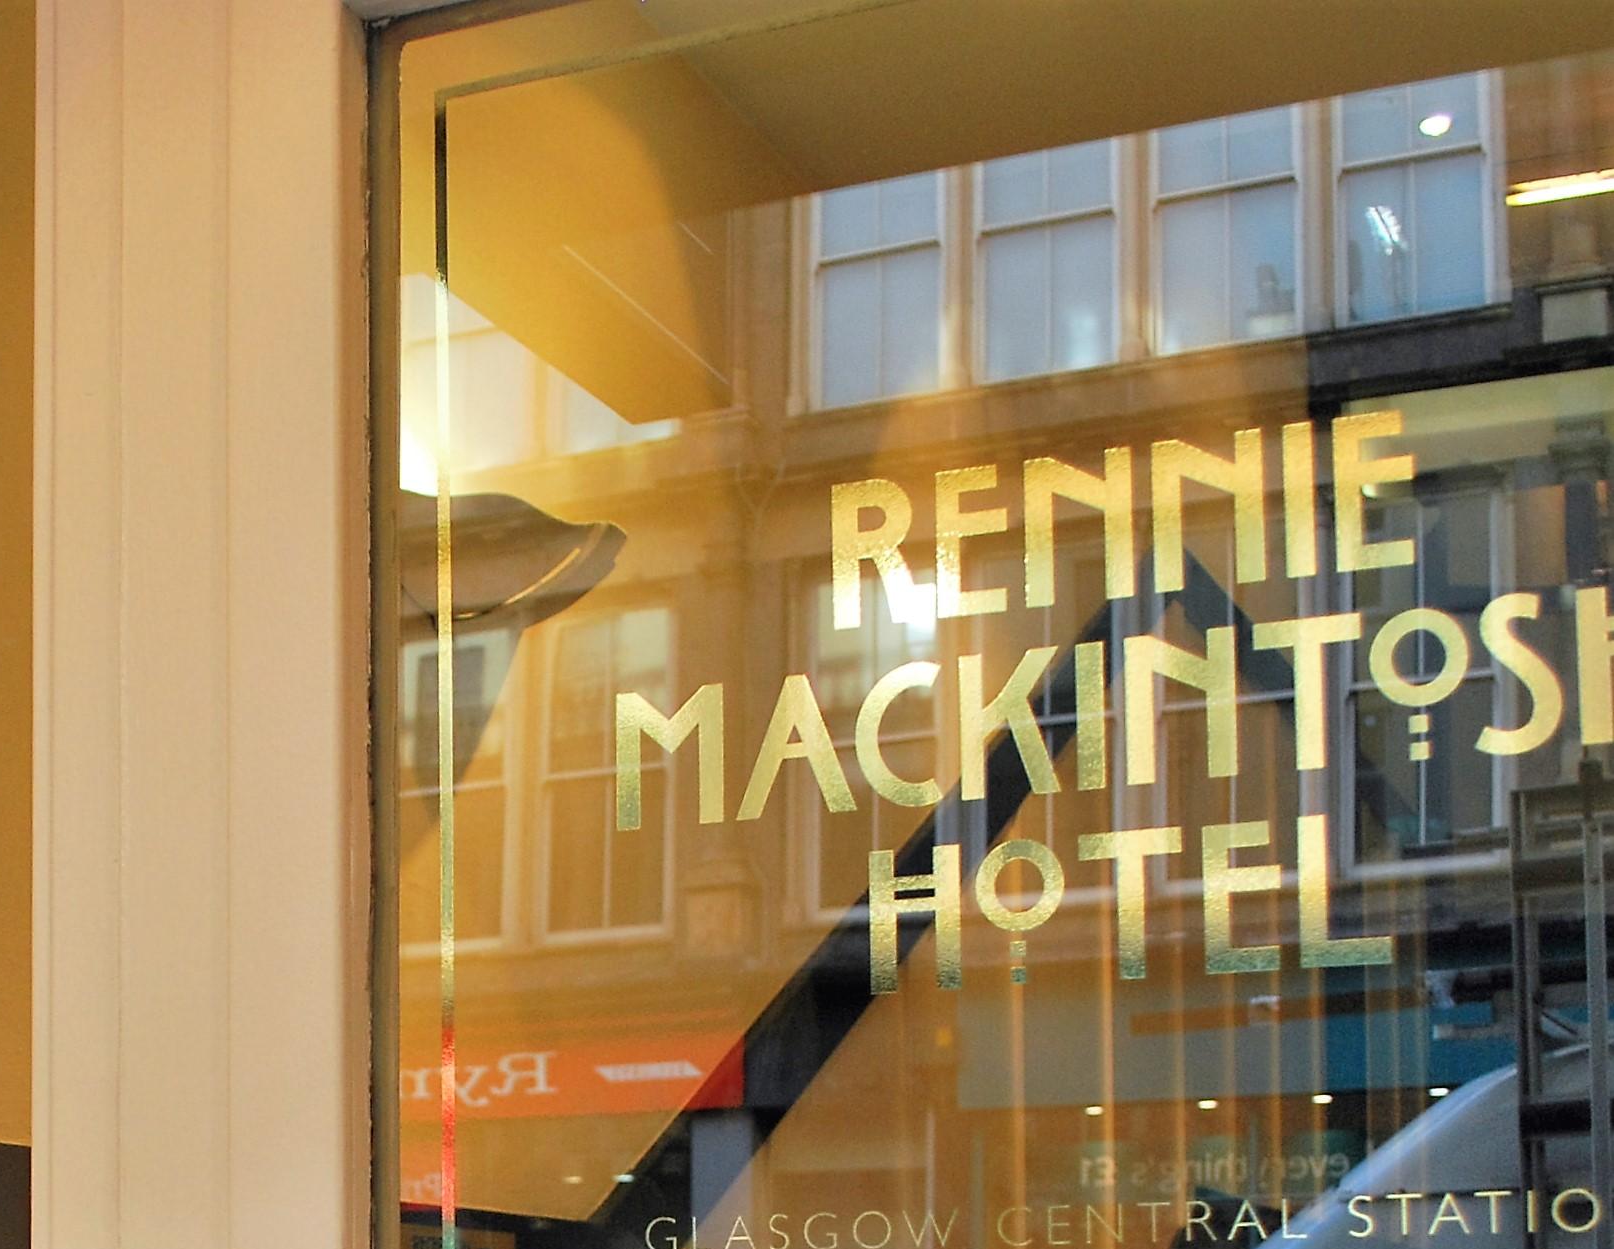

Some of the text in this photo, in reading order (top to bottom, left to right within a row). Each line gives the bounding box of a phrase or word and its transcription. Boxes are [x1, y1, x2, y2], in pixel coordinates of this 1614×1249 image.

[830, 411, 1416, 630] RENNIE
[867, 814, 1393, 995] HOTEL
[996, 1199, 1309, 1247] CENTRAL
[1346, 1187, 1601, 1239] STATIO
